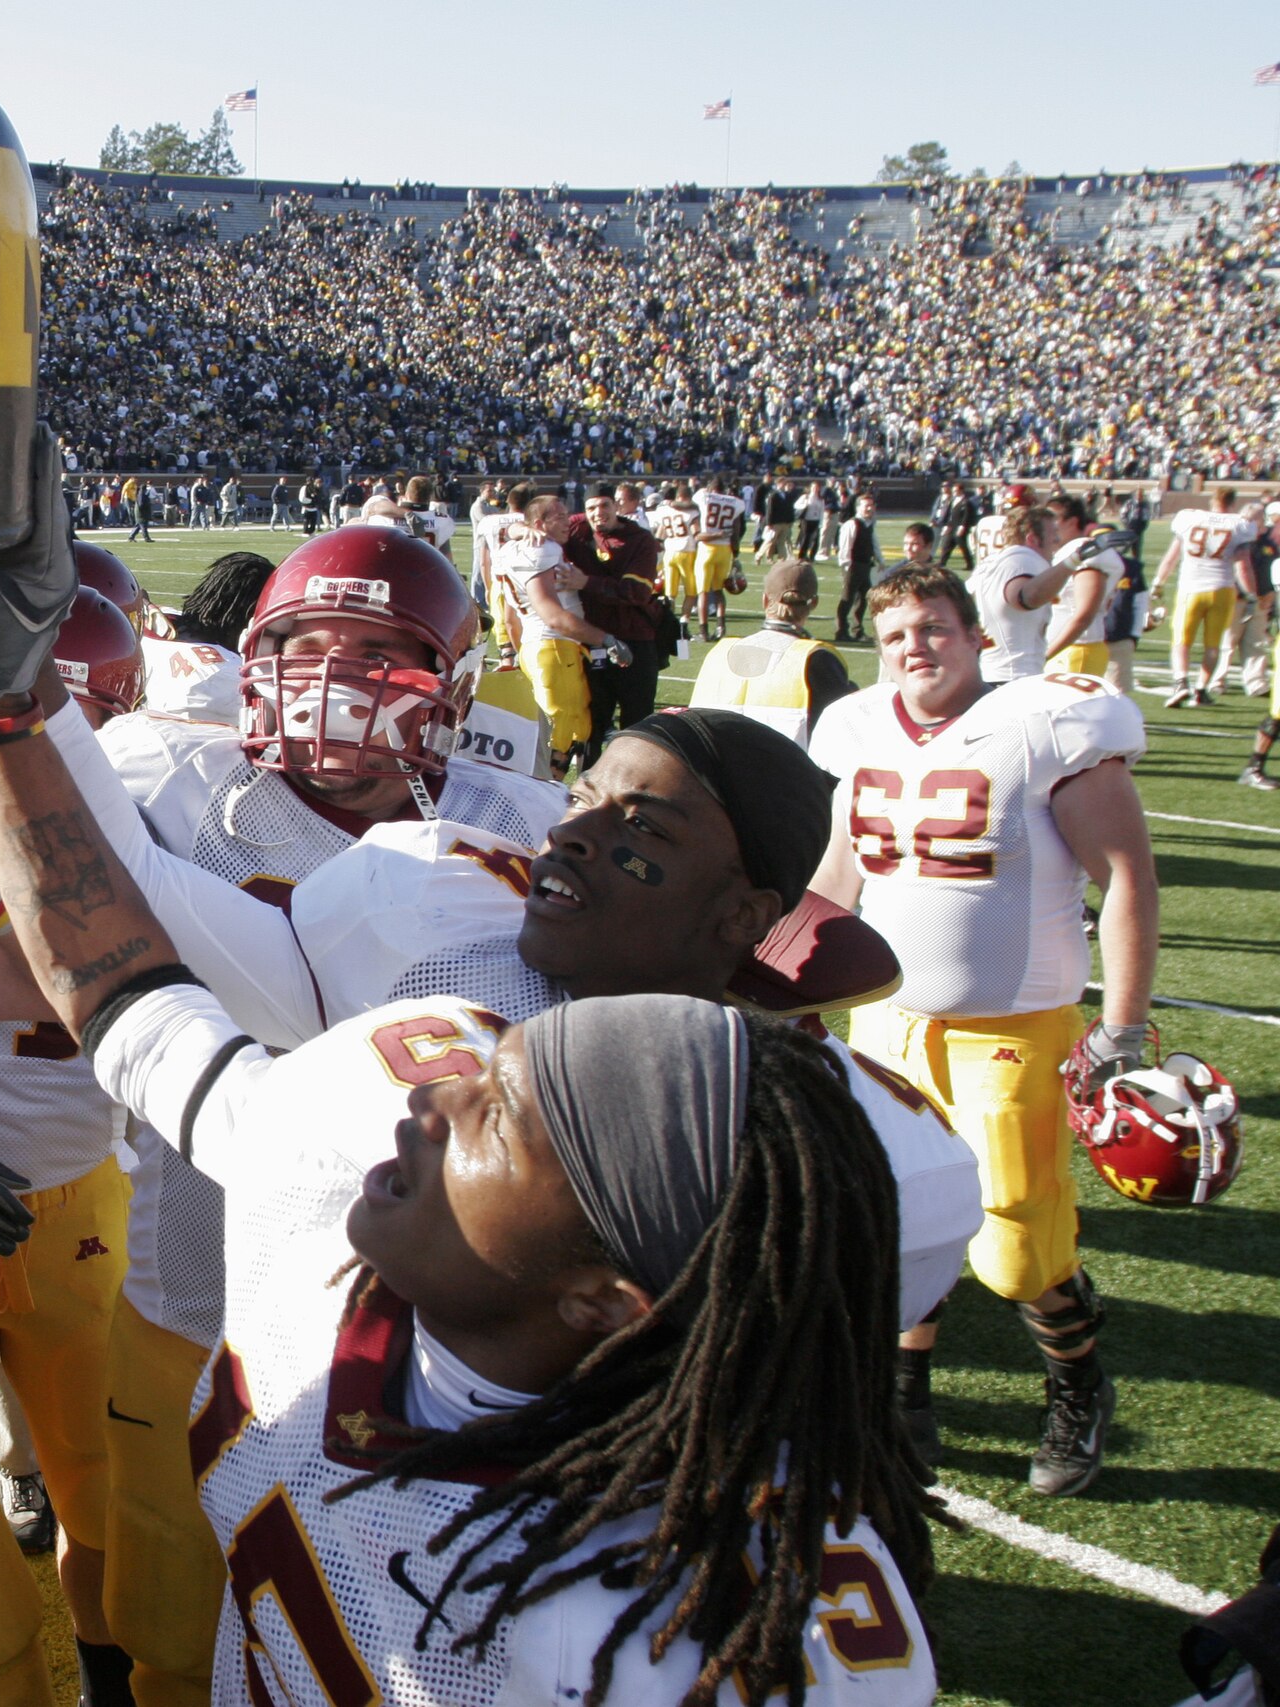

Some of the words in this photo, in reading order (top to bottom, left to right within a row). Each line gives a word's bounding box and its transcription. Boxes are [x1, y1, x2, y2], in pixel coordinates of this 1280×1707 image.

[661, 514, 689, 538] 83
[705, 502, 736, 530] 82
[1187, 526, 1233, 559] 97
[326, 581, 370, 594] GOPHERS
[455, 728, 515, 762] OTO
[849, 766, 998, 881] 62
